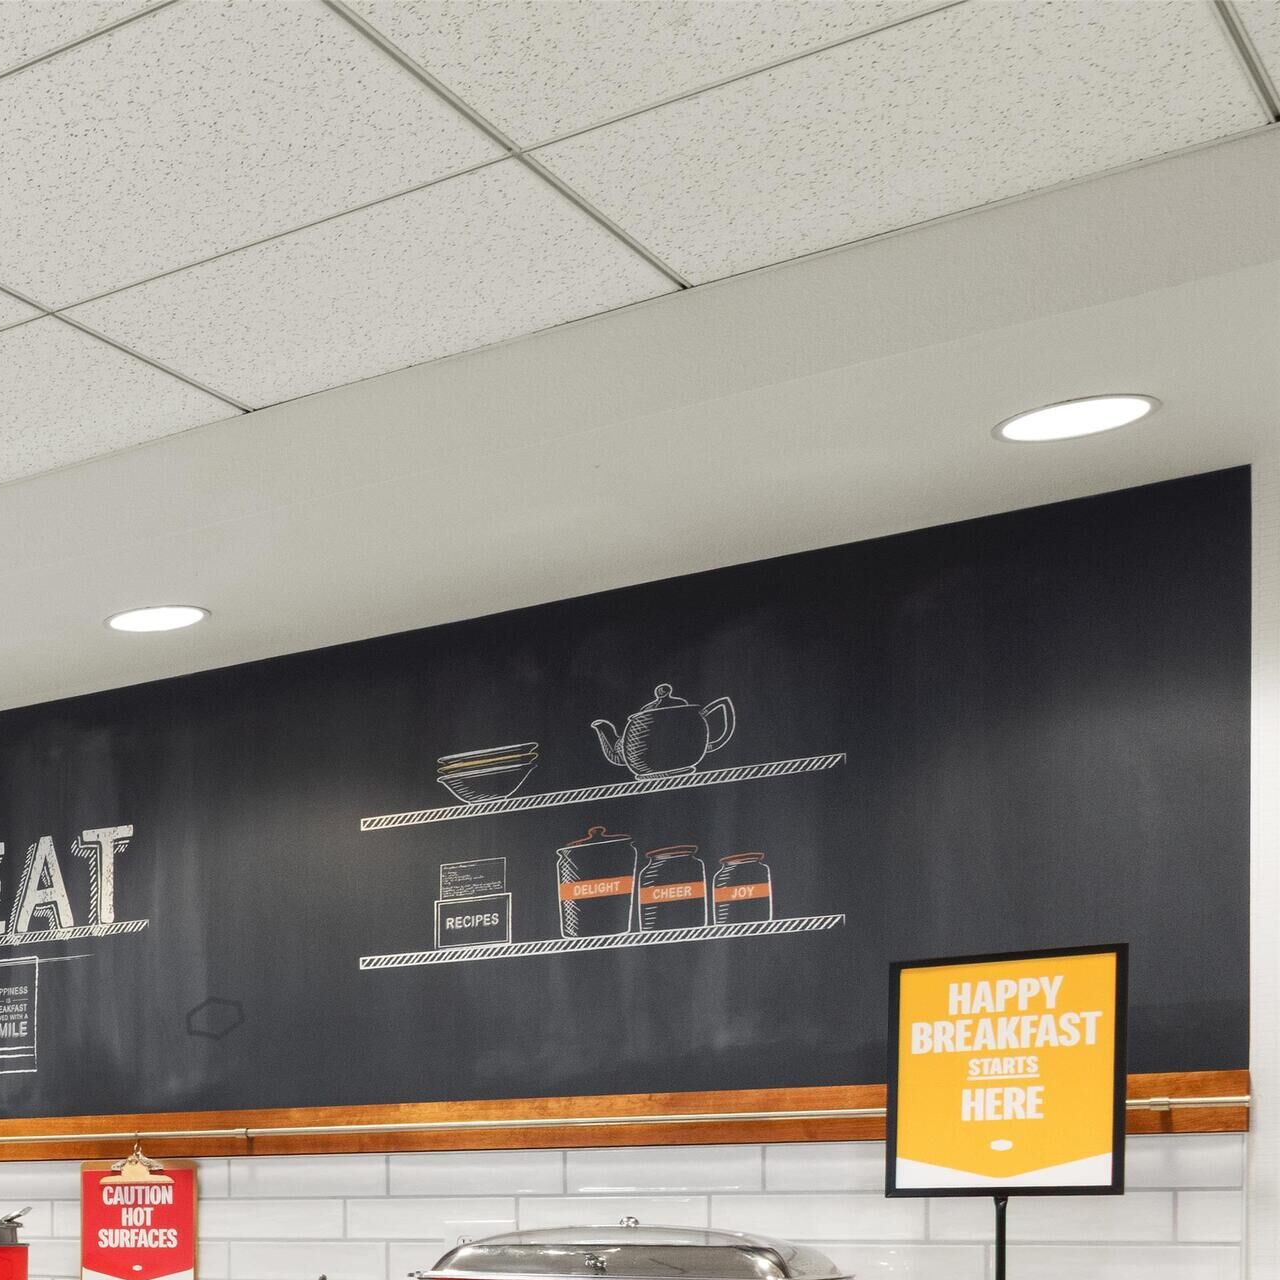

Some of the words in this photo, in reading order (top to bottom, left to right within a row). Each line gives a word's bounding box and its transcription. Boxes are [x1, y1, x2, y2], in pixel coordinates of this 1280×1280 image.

[573, 881, 620, 897] DELIGHT
[652, 886, 692, 899] CHEER
[731, 887, 755, 899] JOY
[446, 913, 499, 930] RECIPES
[948, 976, 1063, 1015] HAPPY
[911, 1011, 1103, 1055] BREAKFAST
[968, 1056, 1039, 1076] STARTS
[961, 1085, 1045, 1122] HERE
[102, 1186, 173, 1205] CAUTION
[121, 1207, 154, 1226] HOT
[98, 1228, 178, 1248] SURFACES
